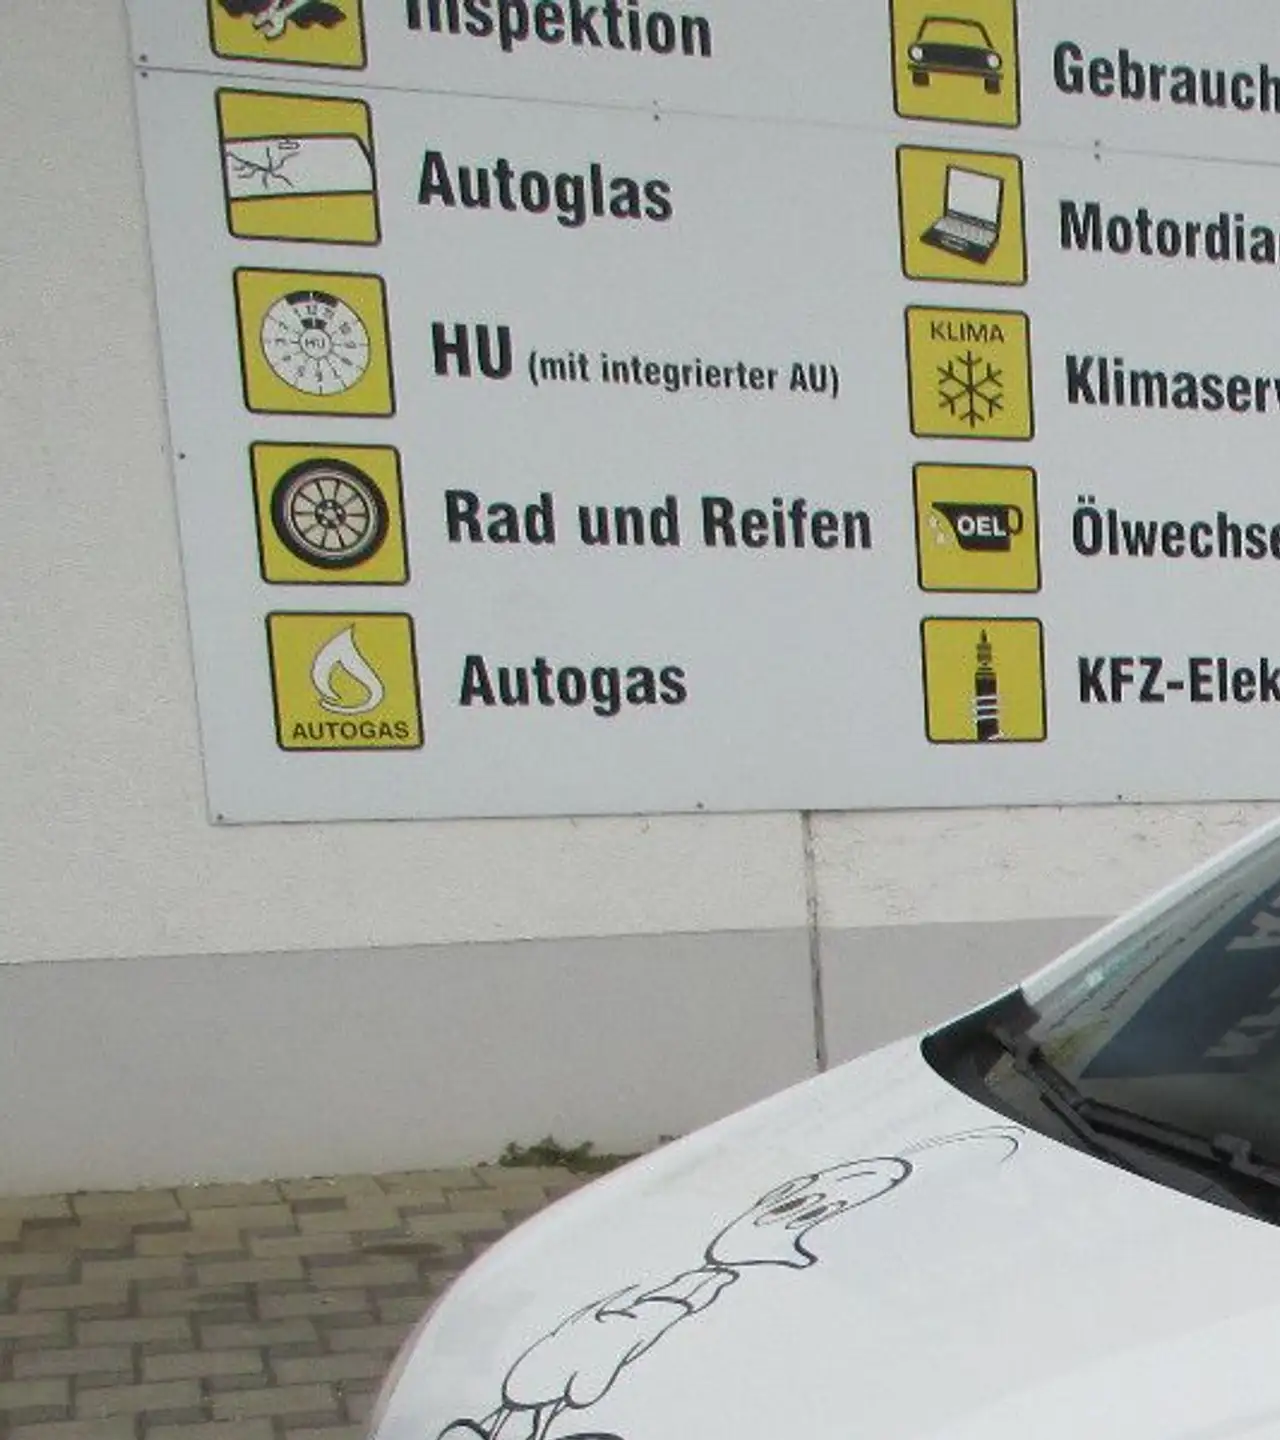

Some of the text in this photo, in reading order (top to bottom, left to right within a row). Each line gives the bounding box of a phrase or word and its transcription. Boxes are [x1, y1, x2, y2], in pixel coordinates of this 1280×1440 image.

[418, 150, 672, 228] Autoglas
[432, 322, 838, 399] HU (mit integrierter AU)
[931, 321, 1004, 343] KLIMA
[445, 490, 871, 549] Rad und Reifen
[957, 515, 1007, 537] OEL
[460, 655, 687, 716] Autogas
[293, 721, 409, 740] AUTOGAS
